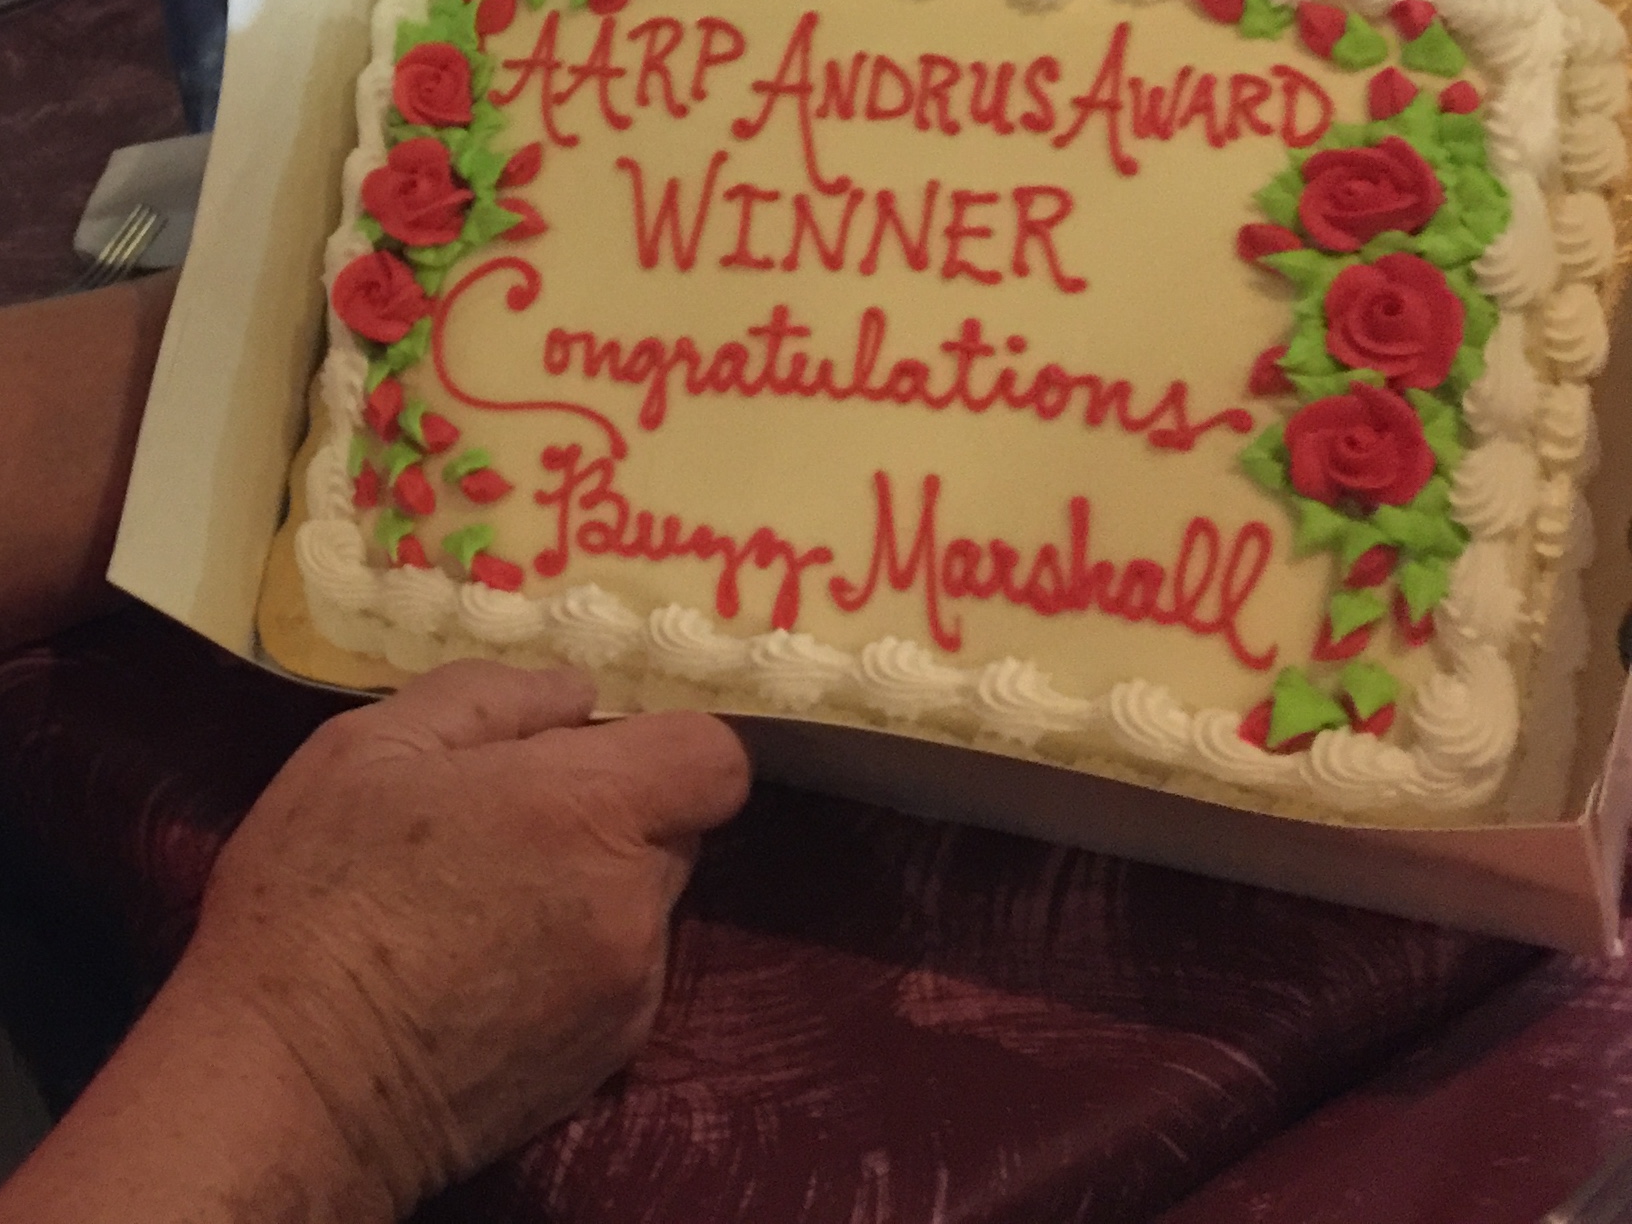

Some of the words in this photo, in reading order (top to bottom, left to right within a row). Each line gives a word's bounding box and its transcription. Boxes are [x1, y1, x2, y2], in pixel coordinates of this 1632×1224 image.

[489, 10, 746, 147] AARP
[615, 150, 1088, 294] WINNER
[430, 256, 1255, 460] Congratulations
[827, 470, 1277, 672] Marshall
